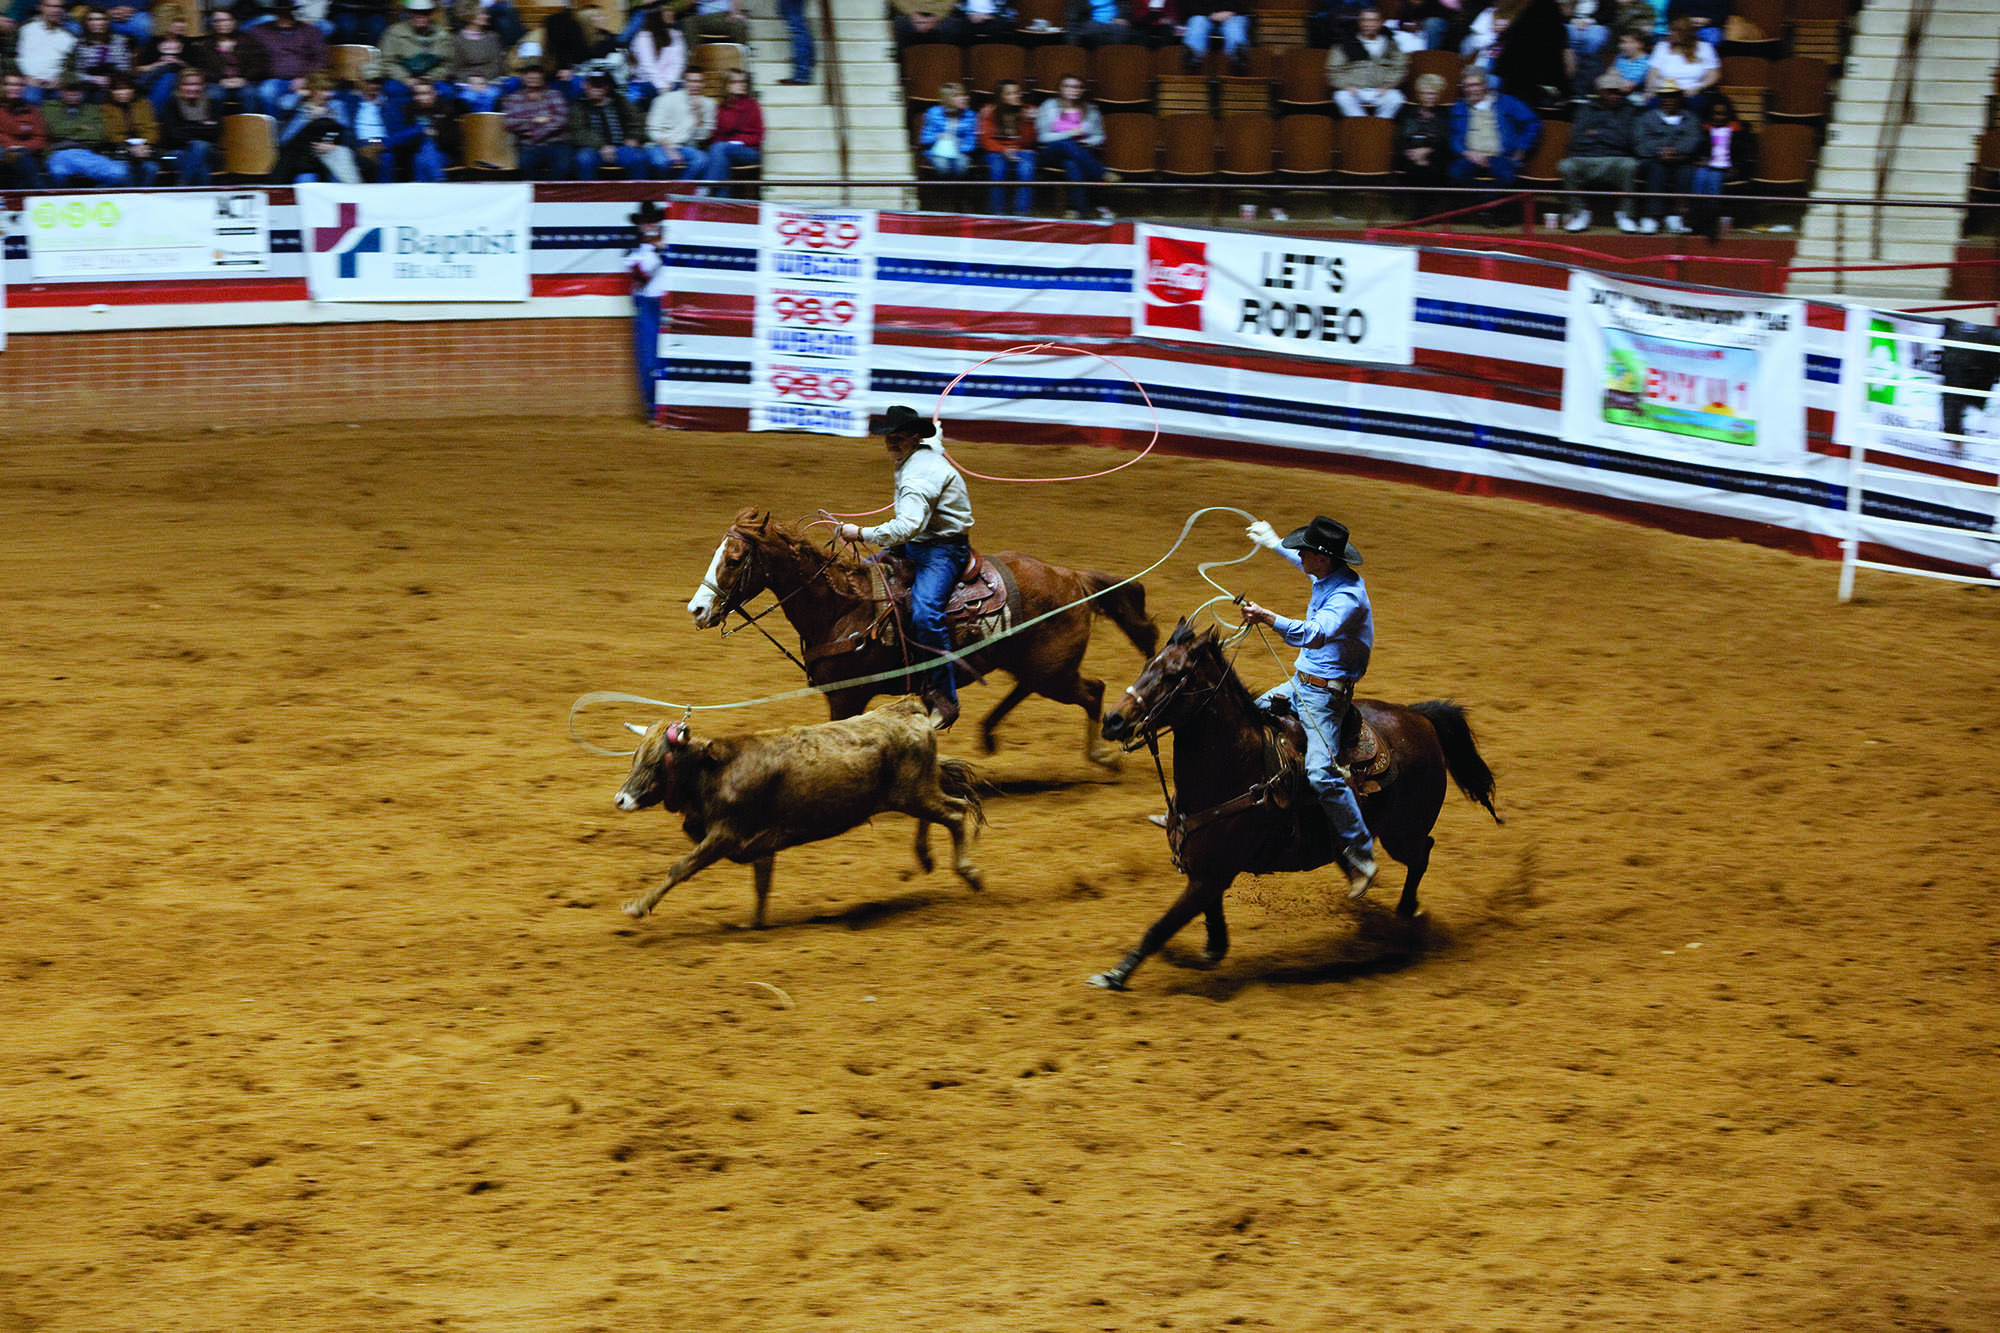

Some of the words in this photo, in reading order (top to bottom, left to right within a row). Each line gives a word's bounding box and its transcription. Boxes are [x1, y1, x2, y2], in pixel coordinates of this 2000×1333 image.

[393, 226, 518, 263] Baptist
[776, 219, 862, 249] 98.9
[771, 296, 858, 325] 98.9
[1237, 298, 1367, 344] RODEO
[768, 372, 856, 401] 98.9
